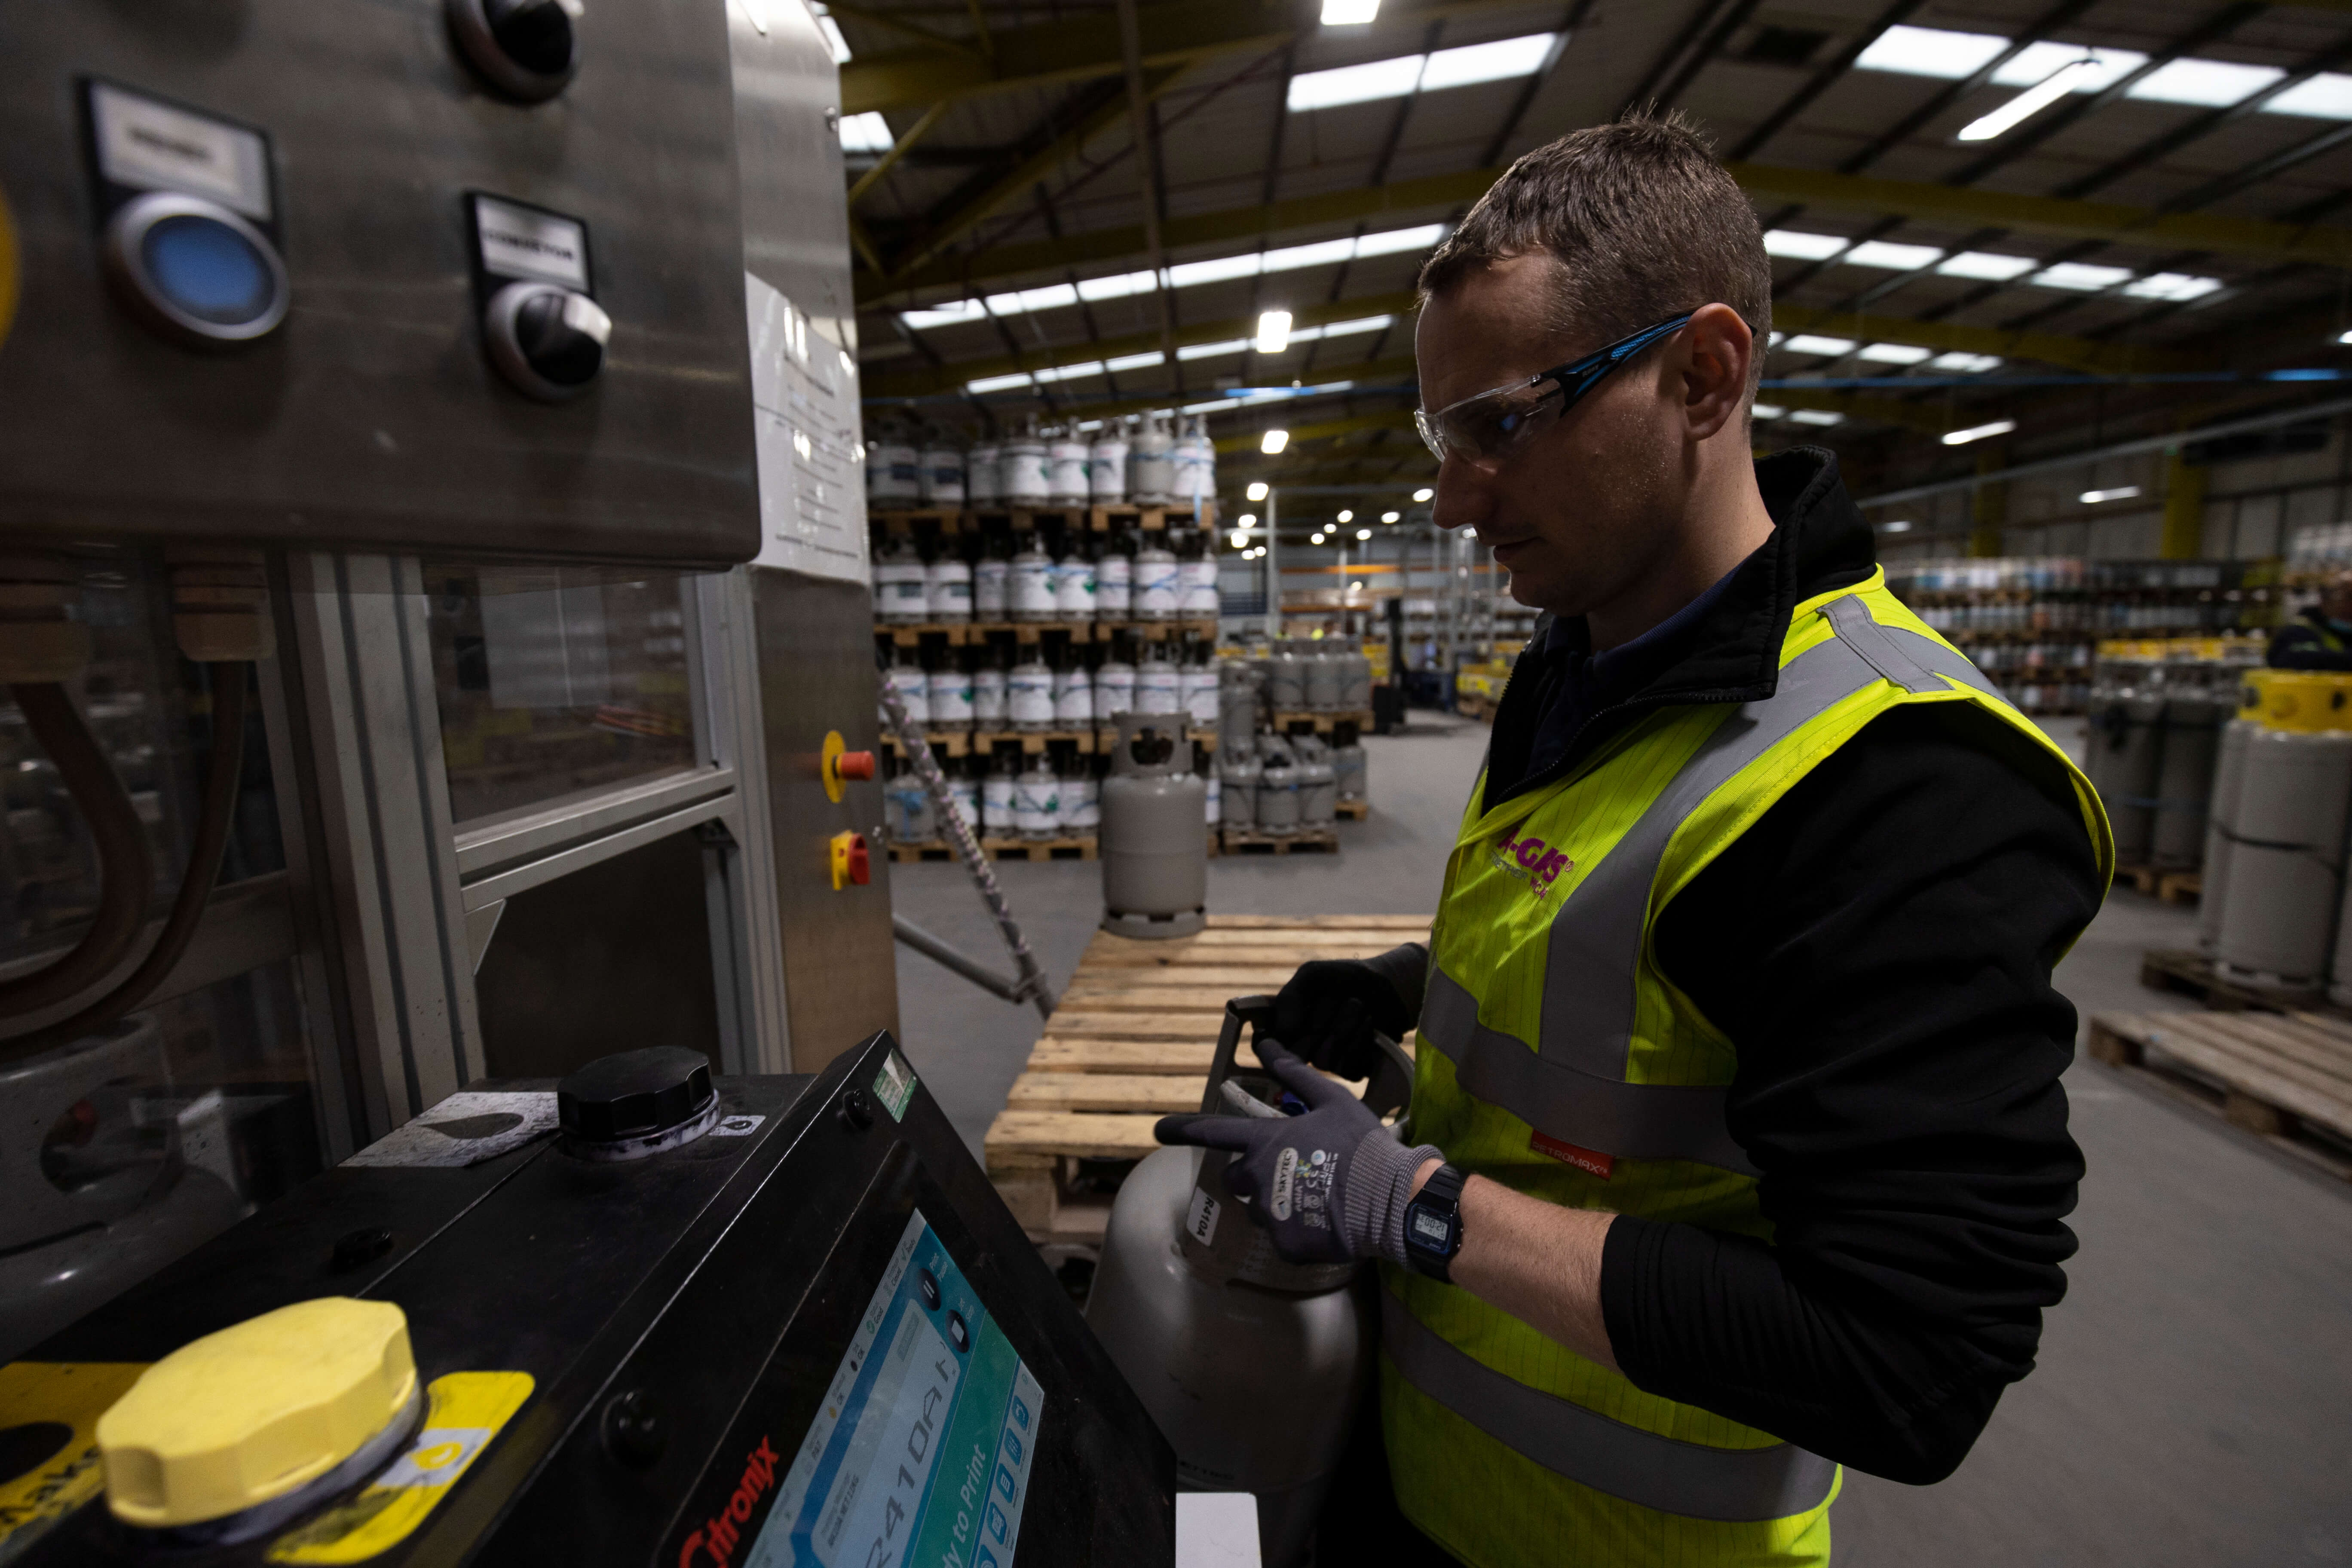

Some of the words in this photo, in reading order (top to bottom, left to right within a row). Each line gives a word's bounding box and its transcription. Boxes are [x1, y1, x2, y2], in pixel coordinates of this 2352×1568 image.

[1197, 1197, 1215, 1237] R410A
[929, 1252, 938, 1271] Print
[937, 1261, 948, 1282] Pause
[891, 1268, 901, 1286] Closed
[874, 1307, 884, 1325] Good
[858, 1348, 865, 1360] OK
[959, 1443, 986, 1510] Print
[678, 1434, 780, 1568] Citronix
[952, 1509, 970, 1544] to
